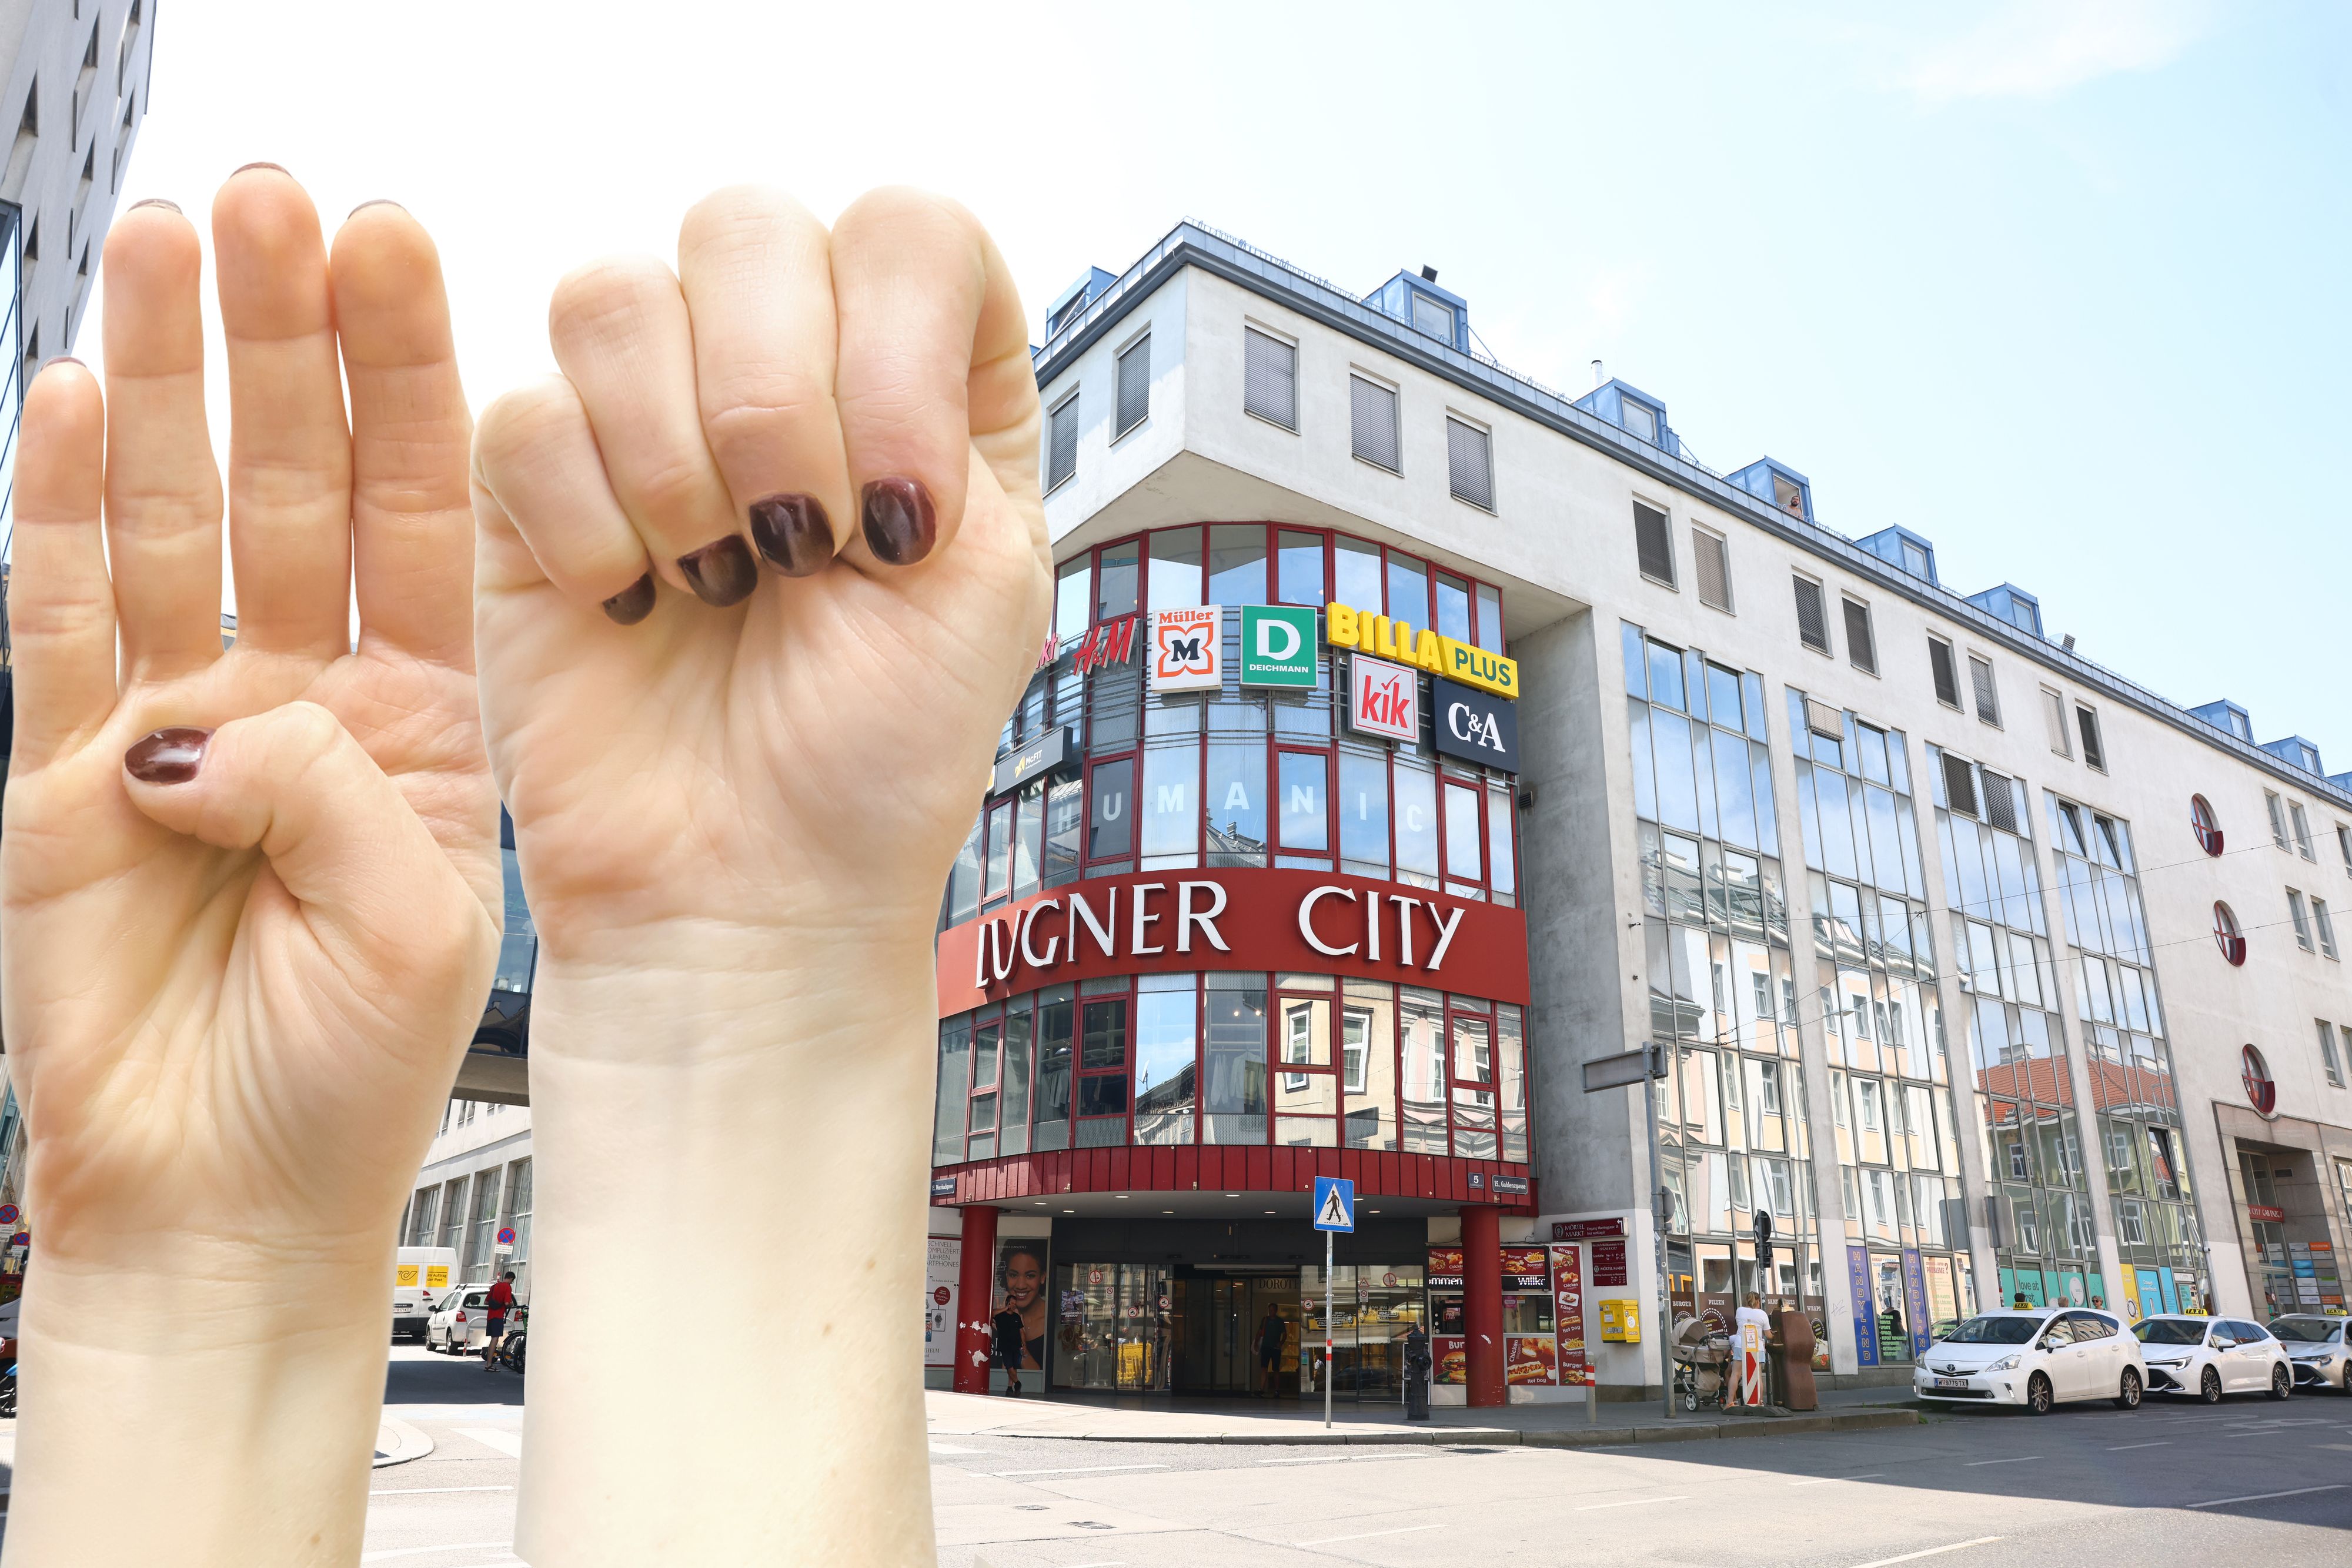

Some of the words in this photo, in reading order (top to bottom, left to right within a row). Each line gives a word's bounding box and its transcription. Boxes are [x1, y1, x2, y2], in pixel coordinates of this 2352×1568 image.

[1159, 610, 1214, 624] Müller
[1073, 617, 1135, 677] H&M
[1171, 638, 1200, 662] M
[1257, 619, 1301, 660] D
[1327, 602, 1443, 674] BILLA
[1455, 647, 1511, 686] PLUS
[1250, 664, 1308, 673] DEICHMANN
[1361, 674, 1410, 728] kik
[1448, 702, 1506, 753] C&A
[1058, 781, 1423, 833] HUMANIC
[974, 881, 1231, 990] LUGNER
[1298, 885, 1465, 972] CITY
[1474, 1175, 1479, 1183] 5
[1501, 1181, 1526, 1190] Gablenzgasse
[1558, 1247, 1574, 1255] Wraps
[2019, 1279, 2031, 1290] love
[2033, 1281, 2039, 1290] at
[1853, 1251, 1871, 1360] HANDYLAND
[1509, 1339, 1519, 1363] Chicken
